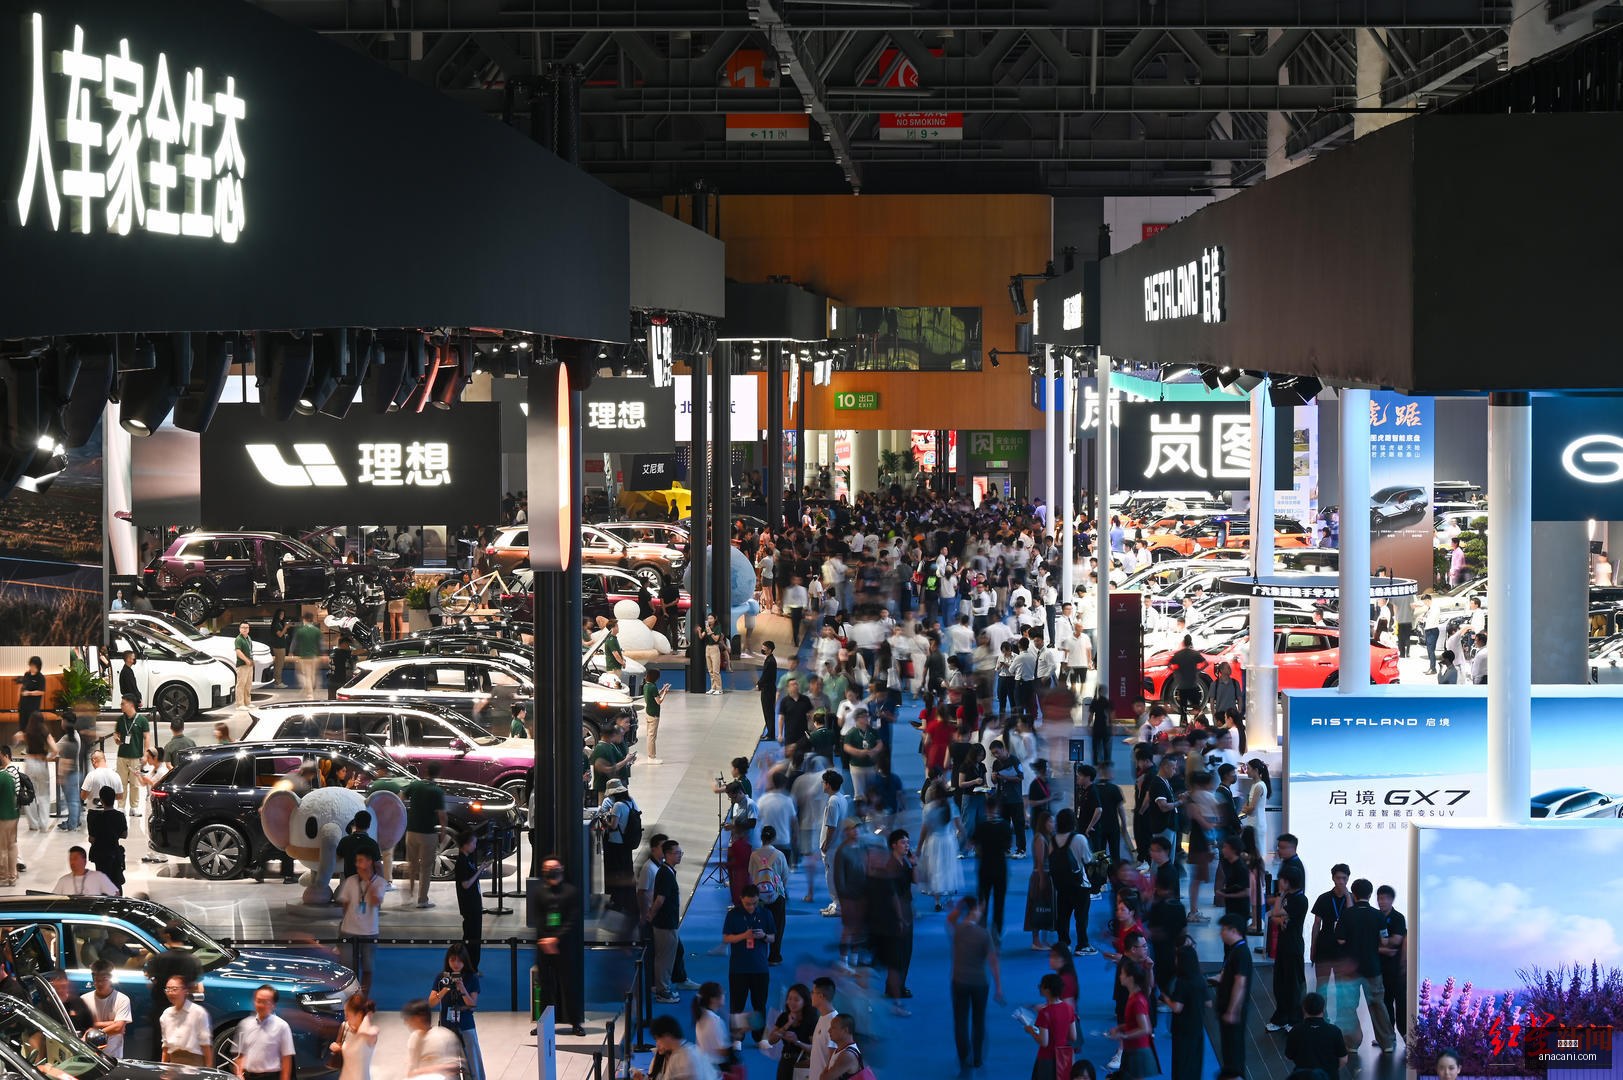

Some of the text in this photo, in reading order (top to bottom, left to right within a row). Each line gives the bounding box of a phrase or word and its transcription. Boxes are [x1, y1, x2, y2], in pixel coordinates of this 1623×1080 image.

[17, 12, 246, 244] 人车家全生态
[908, 118, 946, 126] SMOKING
[761, 130, 774, 139] 11
[921, 130, 928, 139] 9
[838, 394, 874, 408] 10 出口
[588, 401, 646, 429] 理想
[358, 441, 451, 486] 理想
[1311, 718, 1450, 727] AISTALAND 启境
[1329, 789, 1471, 806] 启境 GX7
